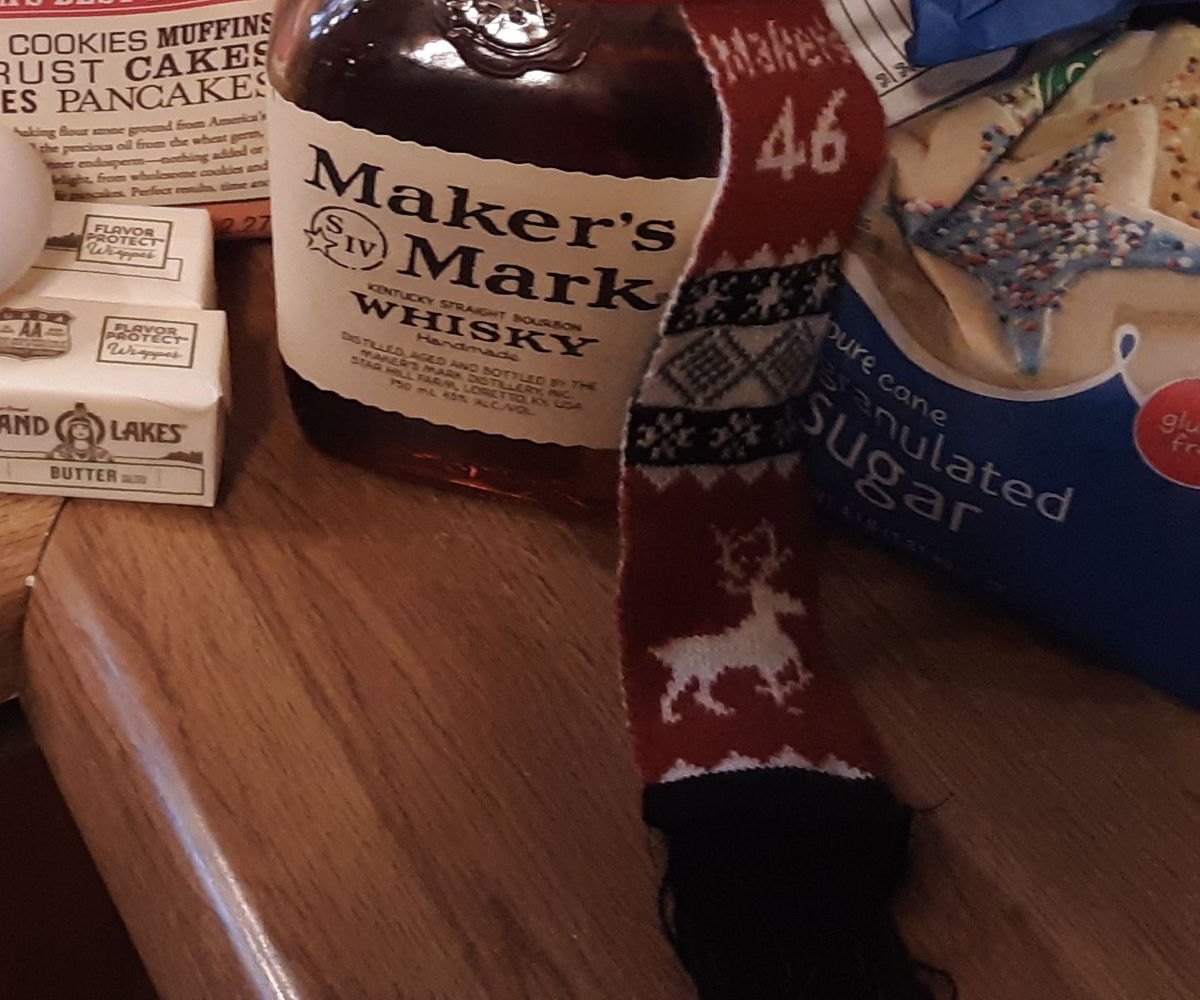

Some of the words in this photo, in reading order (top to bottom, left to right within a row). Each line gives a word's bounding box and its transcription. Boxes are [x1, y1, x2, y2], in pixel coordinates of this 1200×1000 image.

[9, 30, 147, 56] COOKIES
[157, 11, 274, 49] MUFFINS
[125, 40, 270, 82] CAKES
[56, 72, 268, 115] PANCAKES
[128, 121, 173, 137] ground
[176, 118, 206, 131] from
[209, 112, 267, 128] America's
[755, 87, 848, 182] 46
[116, 139, 134, 151] oil
[136, 138, 166, 150] from
[169, 136, 189, 148] the
[192, 133, 228, 146] wheat
[212, 147, 249, 160] added
[250, 145, 264, 156] or
[96, 172, 128, 184] from
[130, 168, 197, 183] wholesome
[200, 164, 245, 178] cookies
[246, 160, 269, 173] and
[131, 185, 173, 198] Perfect
[303, 142, 678, 254] Maker's
[94, 223, 155, 239] FLAVOR
[325, 214, 344, 237] S
[85, 232, 158, 248] PROTECT
[344, 234, 378, 260] IV
[396, 232, 665, 312] Mark
[366, 281, 436, 306] KENTUCKY
[439, 298, 508, 321] STRAIGHT
[512, 312, 583, 333] BOURBON
[18, 320, 43, 339] AA
[114, 322, 178, 337] FLAVOR
[349, 289, 600, 358] WHISKY
[104, 330, 183, 346] PROTECT
[416, 331, 521, 363] Handmade
[351, 354, 384, 373] STAR
[385, 364, 416, 382] HILL
[360, 348, 420, 373] MAKER'S
[422, 363, 462, 381] MARK
[410, 348, 448, 367] AGED
[450, 359, 479, 375] AND
[482, 364, 547, 387] BOTTLED
[571, 379, 598, 392] THE
[877, 372, 949, 428] cane
[109, 419, 184, 444] LAKES
[49, 464, 118, 483] BUTTER
[803, 391, 985, 533] sugar
